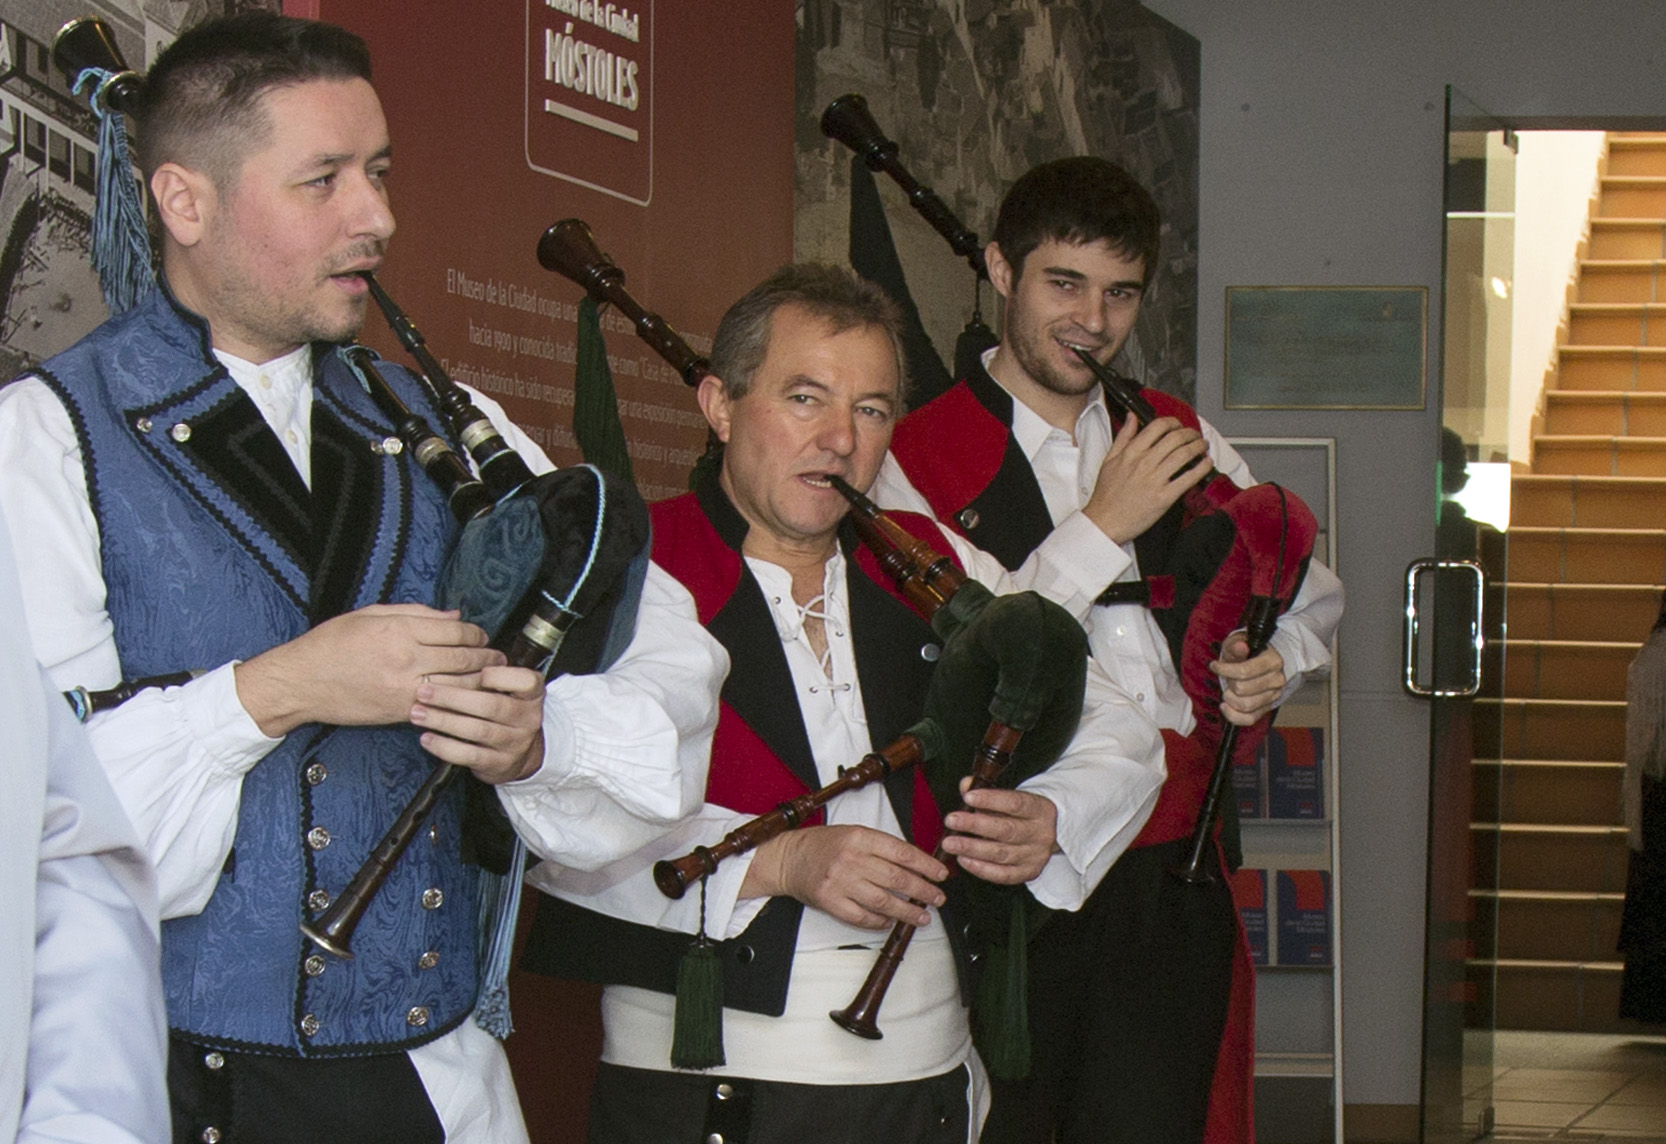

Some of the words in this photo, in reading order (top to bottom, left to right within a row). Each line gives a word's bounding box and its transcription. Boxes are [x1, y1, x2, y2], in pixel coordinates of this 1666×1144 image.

[606, 3, 639, 42] Ciudad
[545, 22, 639, 111] MÓSTOLES
[447, 267, 456, 294] El
[457, 270, 485, 300] Museo
[485, 278, 497, 304] de
[498, 280, 507, 306] la
[507, 283, 537, 313] Ciudad
[468, 317, 492, 348] hacia
[512, 335, 519, 359] y
[519, 335, 555, 360] conocida
